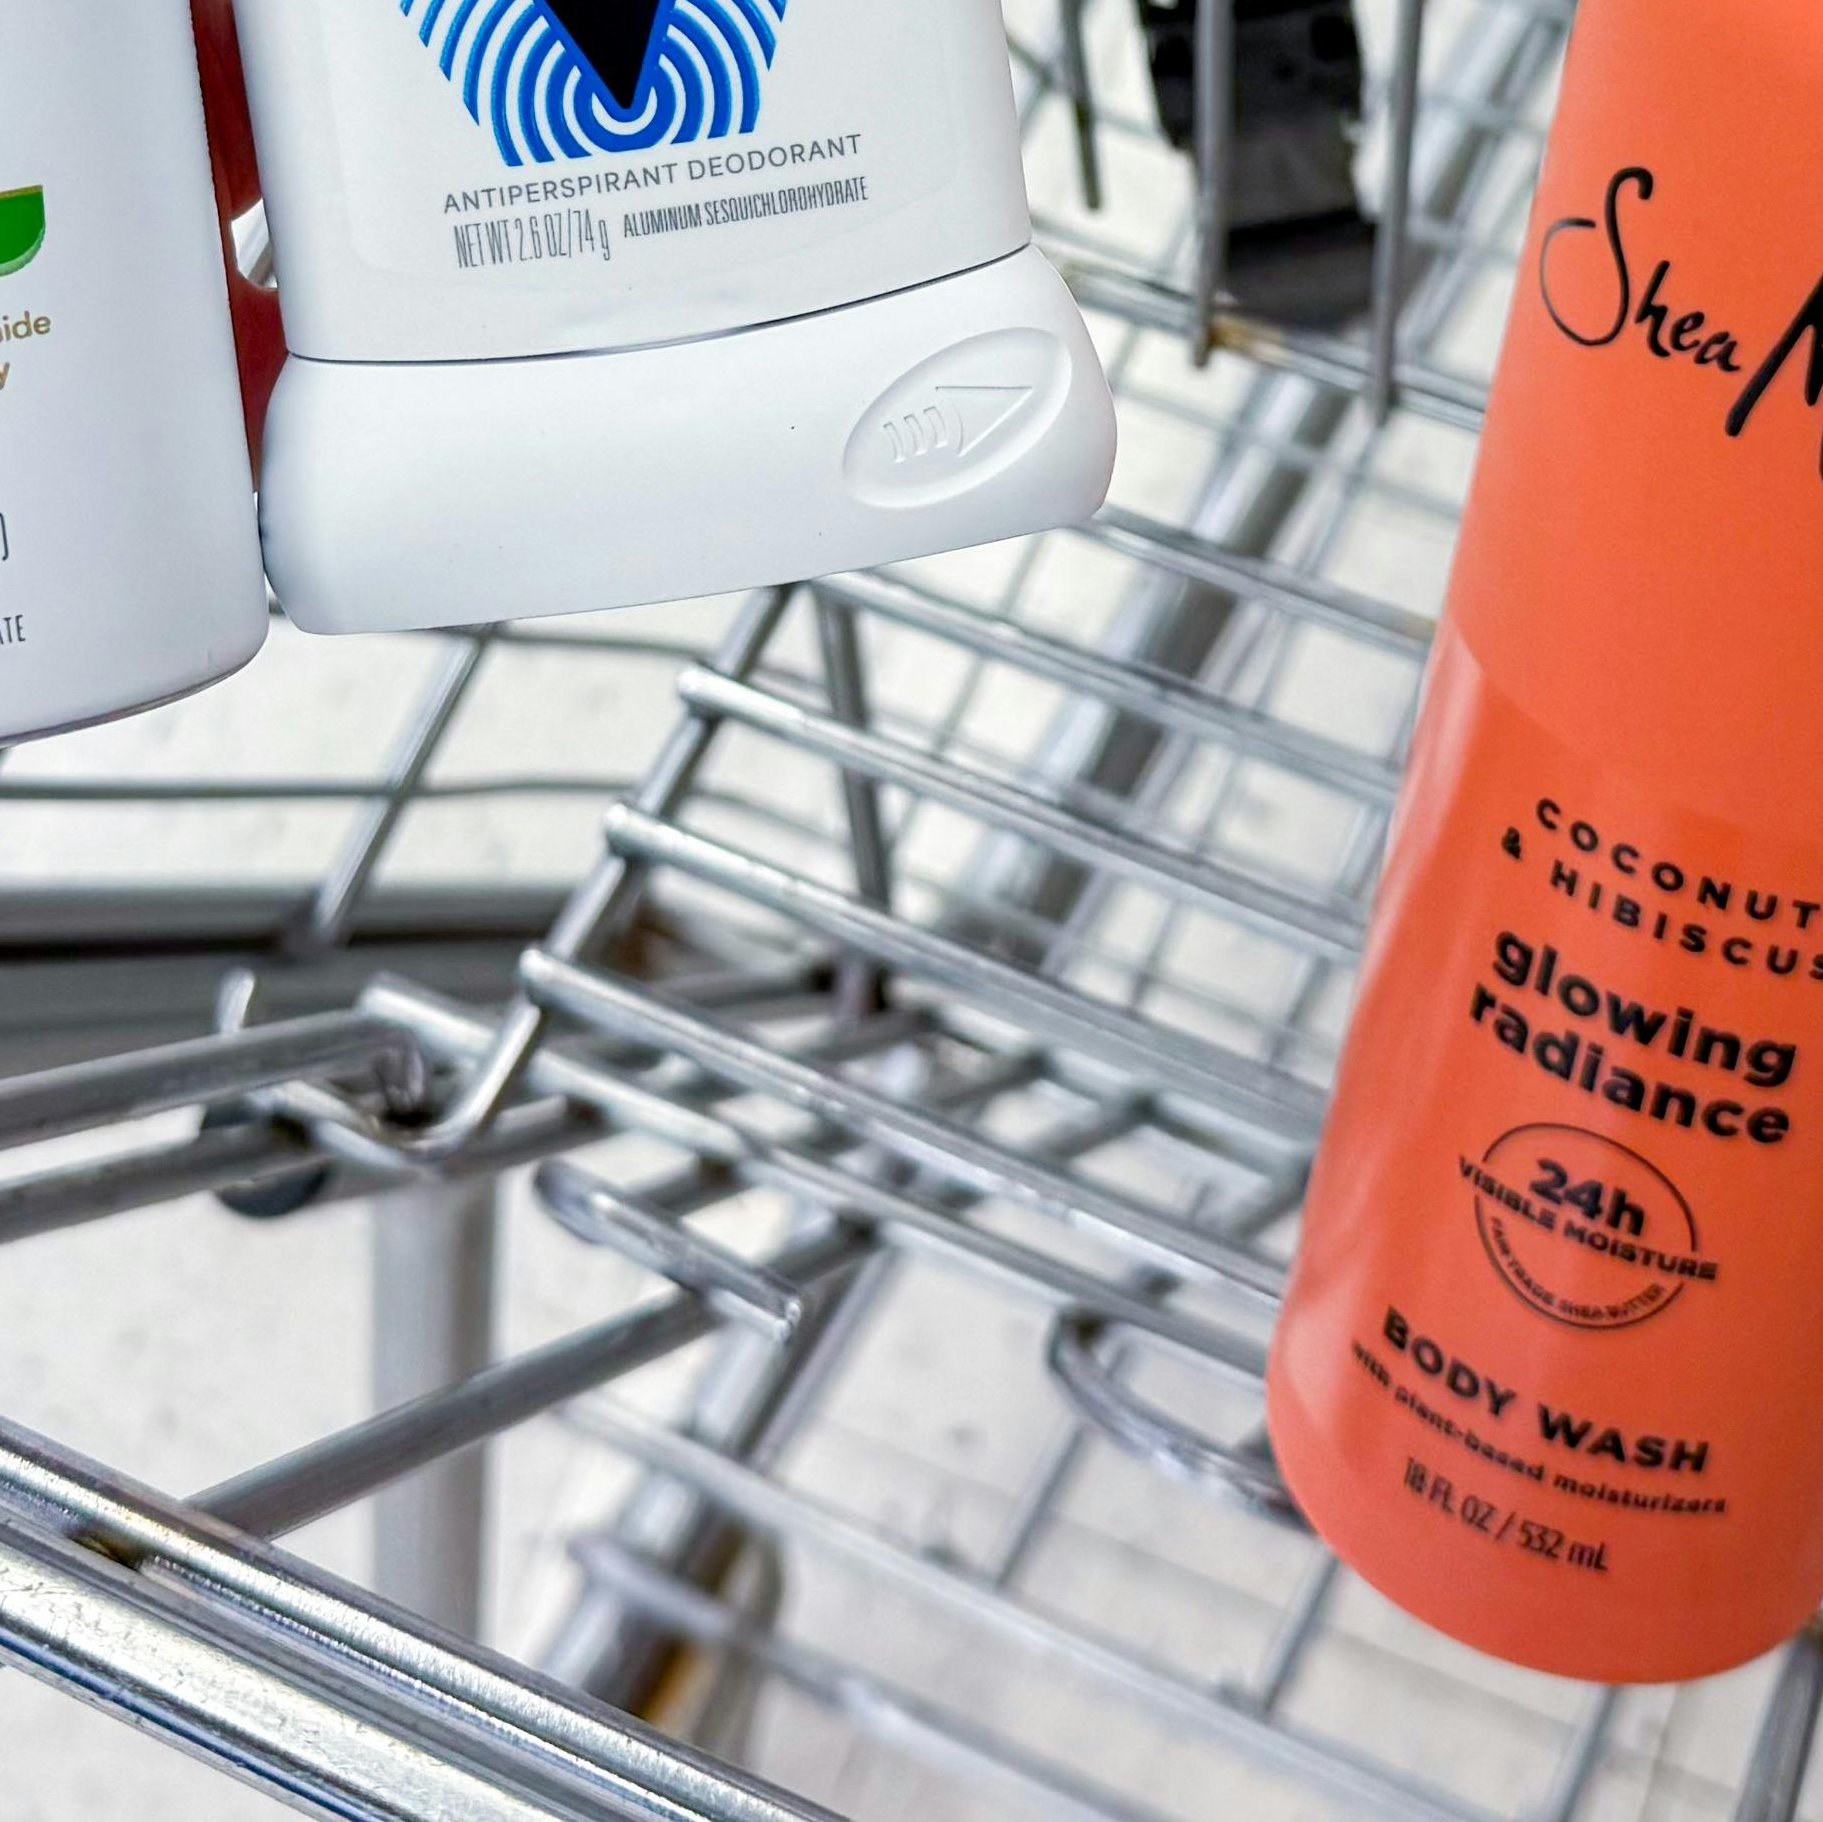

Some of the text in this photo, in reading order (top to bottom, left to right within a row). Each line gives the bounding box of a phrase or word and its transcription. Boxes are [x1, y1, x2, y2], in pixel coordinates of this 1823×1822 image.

[443, 133, 864, 214] ANTIPERSPIRANT DEODORANT
[623, 176, 869, 239] ALUMINUM SESQUICHLOROHYDRATE
[453, 222, 485, 269] NET
[485, 218, 513, 265] WT
[515, 216, 543, 262] 2.6
[1539, 166, 1741, 373] Shea
[1501, 826, 1523, 860] &
[1535, 798, 1821, 929] COCONUT
[1493, 930, 1797, 1088] glowing
[1470, 982, 1791, 1144] radiance
[1459, 1154, 1719, 1281] VISIBLE MOISTURE
[1530, 1157, 1645, 1236] 24h
[1383, 1305, 1710, 1474] BODY WASH
[1461, 1495, 1497, 1532] OZ
[1495, 1511, 1516, 1542] /
[1519, 1519, 1565, 1560] 532
